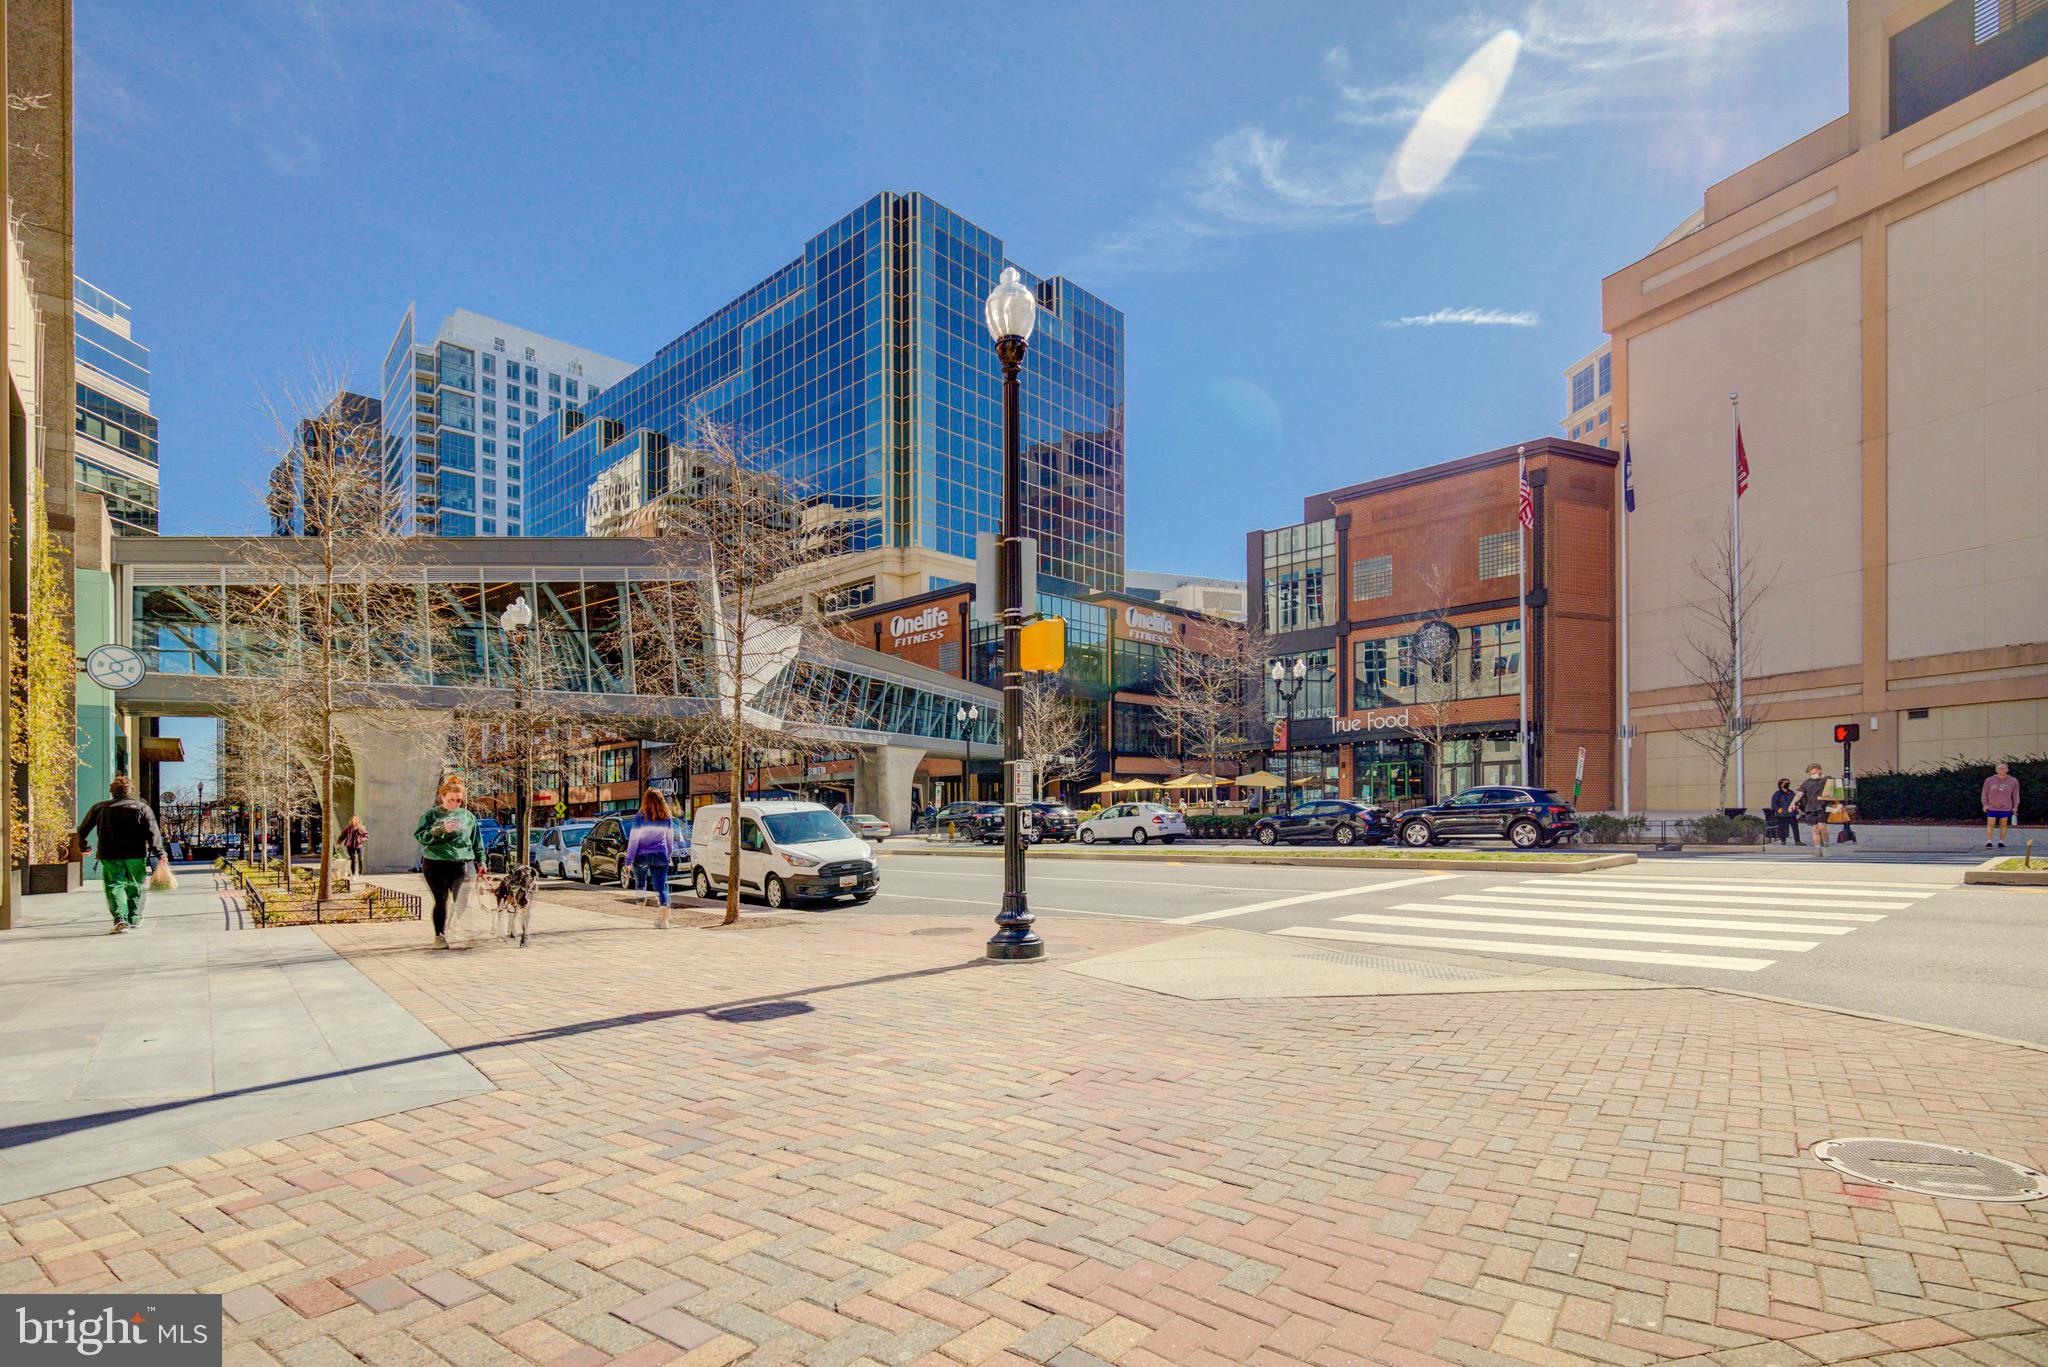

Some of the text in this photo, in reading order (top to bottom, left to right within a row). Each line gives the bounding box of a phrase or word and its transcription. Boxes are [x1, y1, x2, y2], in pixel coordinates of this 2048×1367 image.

[890, 606, 949, 637] Onelife
[1124, 606, 1173, 634] Onelife
[894, 629, 944, 648] FITNESS
[1128, 629, 1170, 644] FITNESS
[1328, 708, 1409, 735] True Food
